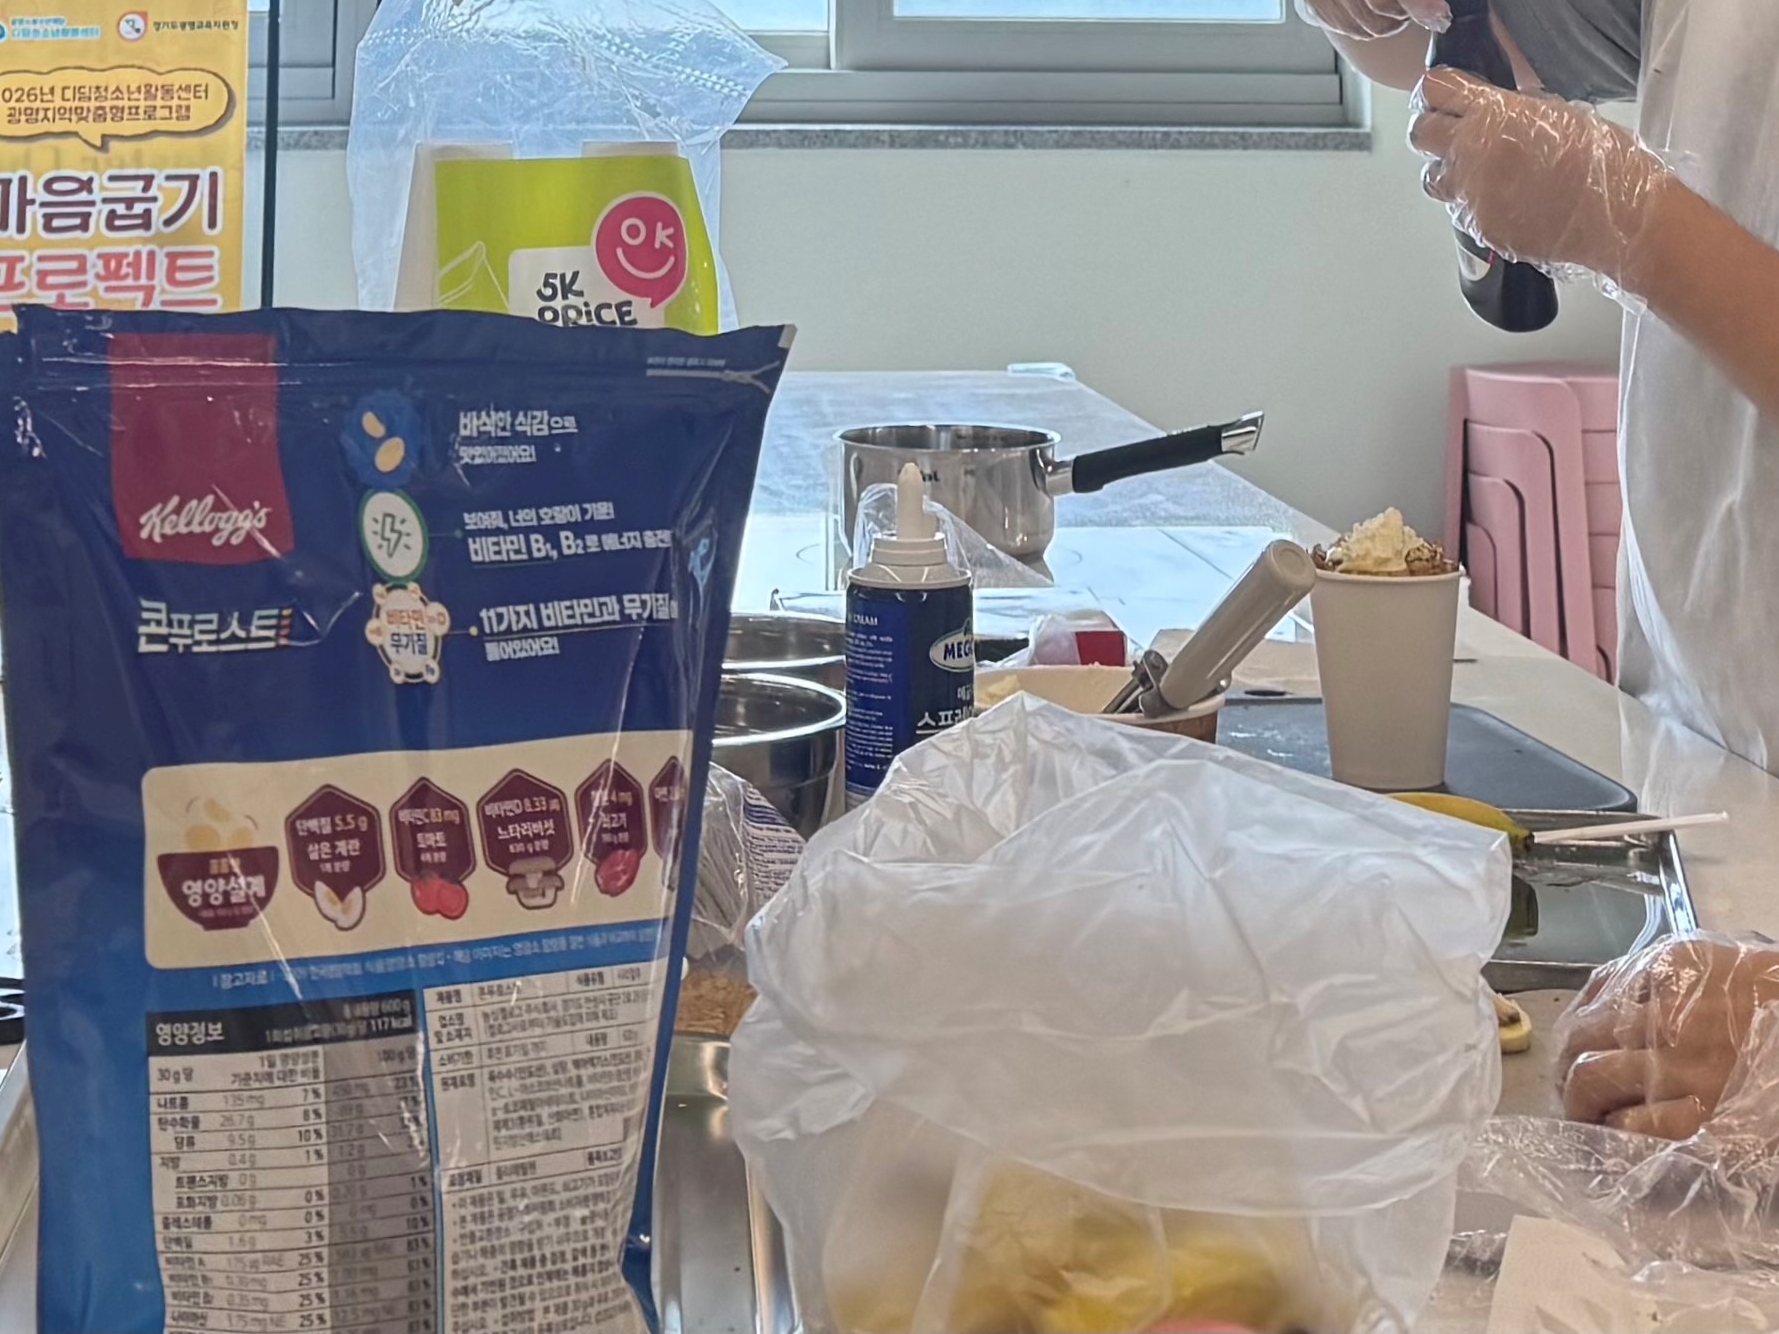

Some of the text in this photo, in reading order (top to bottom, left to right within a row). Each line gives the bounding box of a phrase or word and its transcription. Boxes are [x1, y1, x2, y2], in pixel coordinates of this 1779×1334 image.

[61, 83, 209, 103] 디딤청소년활동센터
[7, 104, 191, 125] 광명지역맞춤형프로그램
[620, 217, 675, 249] OK
[536, 270, 584, 302] 5K
[459, 409, 578, 437] 바삭한 식감으로
[139, 494, 268, 546] Kellogg's
[509, 509, 538, 526] 너의
[538, 503, 582, 525] 호랑이
[467, 534, 529, 562] 비타민
[137, 596, 280, 653] 콘푸로스트
[479, 604, 539, 634] 11가지
[539, 595, 621, 627] 비타민과
[334, 813, 356, 832] 5.5
[497, 818, 556, 840] 느타리버섯
[307, 838, 361, 861] 삶은 계란
[182, 875, 266, 908] 영양설계
[155, 1020, 225, 1046] 영양정보
